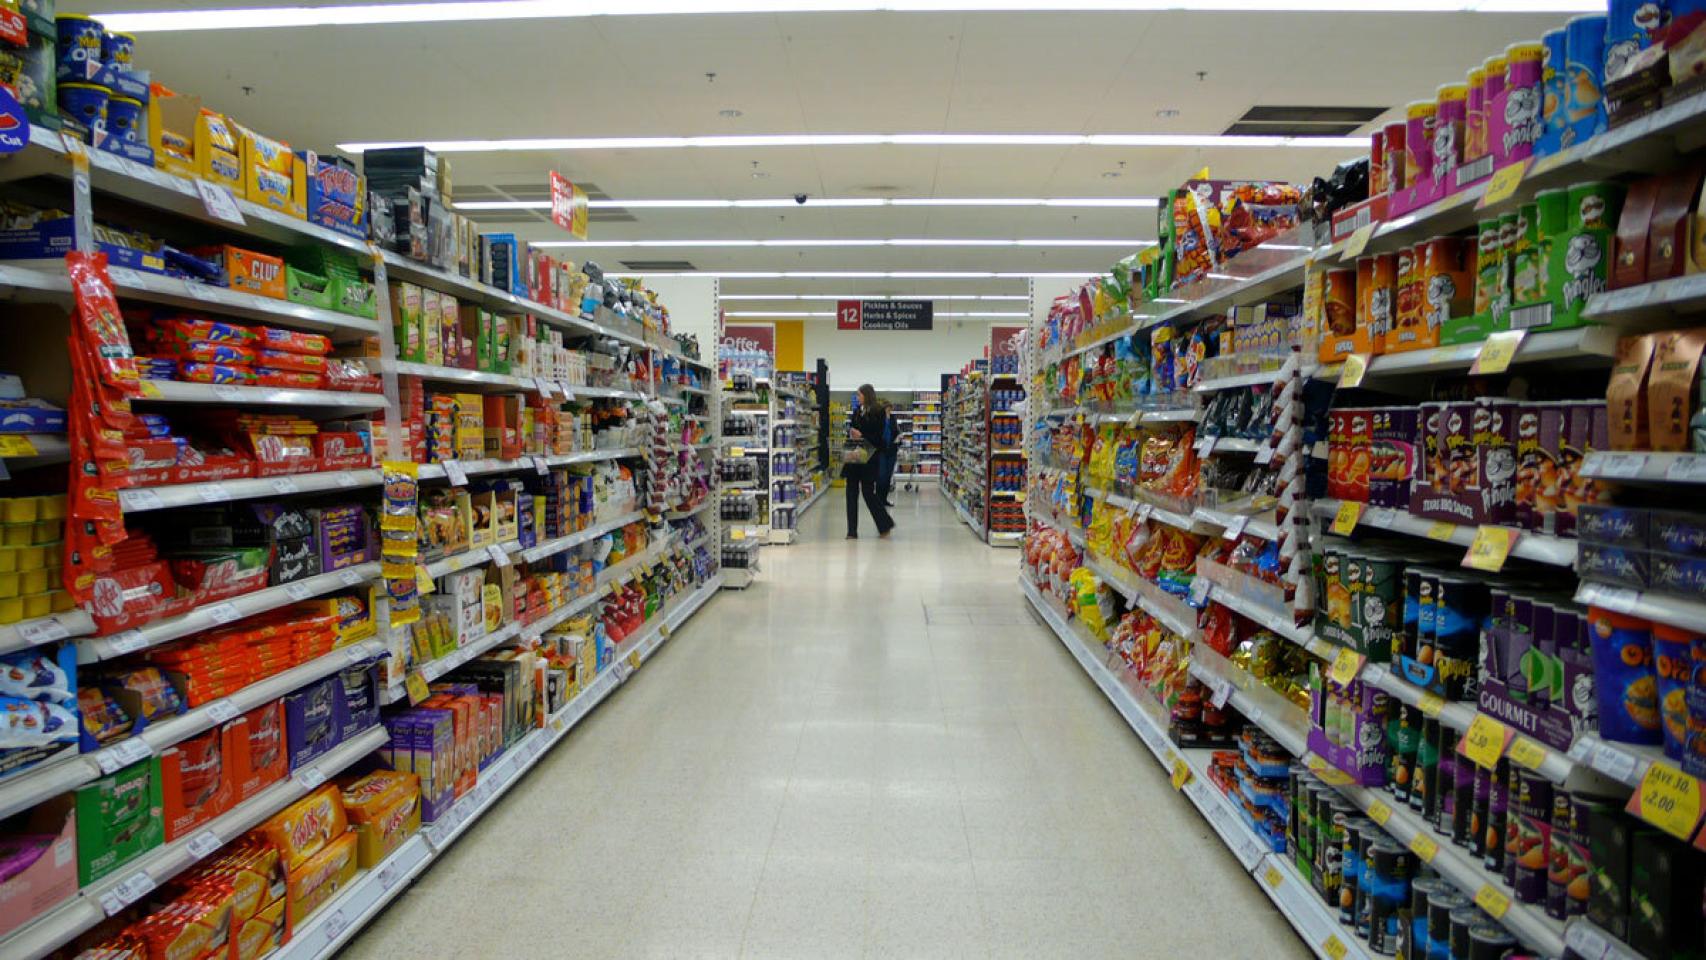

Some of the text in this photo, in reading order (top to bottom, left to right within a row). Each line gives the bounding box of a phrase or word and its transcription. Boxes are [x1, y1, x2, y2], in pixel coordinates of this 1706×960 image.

[863, 302, 923, 310] Pickles & Sauces
[841, 308, 858, 323] 12
[893, 312, 917, 321] Spices
[863, 322, 894, 330] Cooking
[724, 336, 760, 352] Offer
[1454, 501, 1474, 519] SAUCE
[1480, 690, 1538, 734] GOURMET
[1648, 766, 1672, 787] SAVE
[291, 807, 320, 849] Twix
